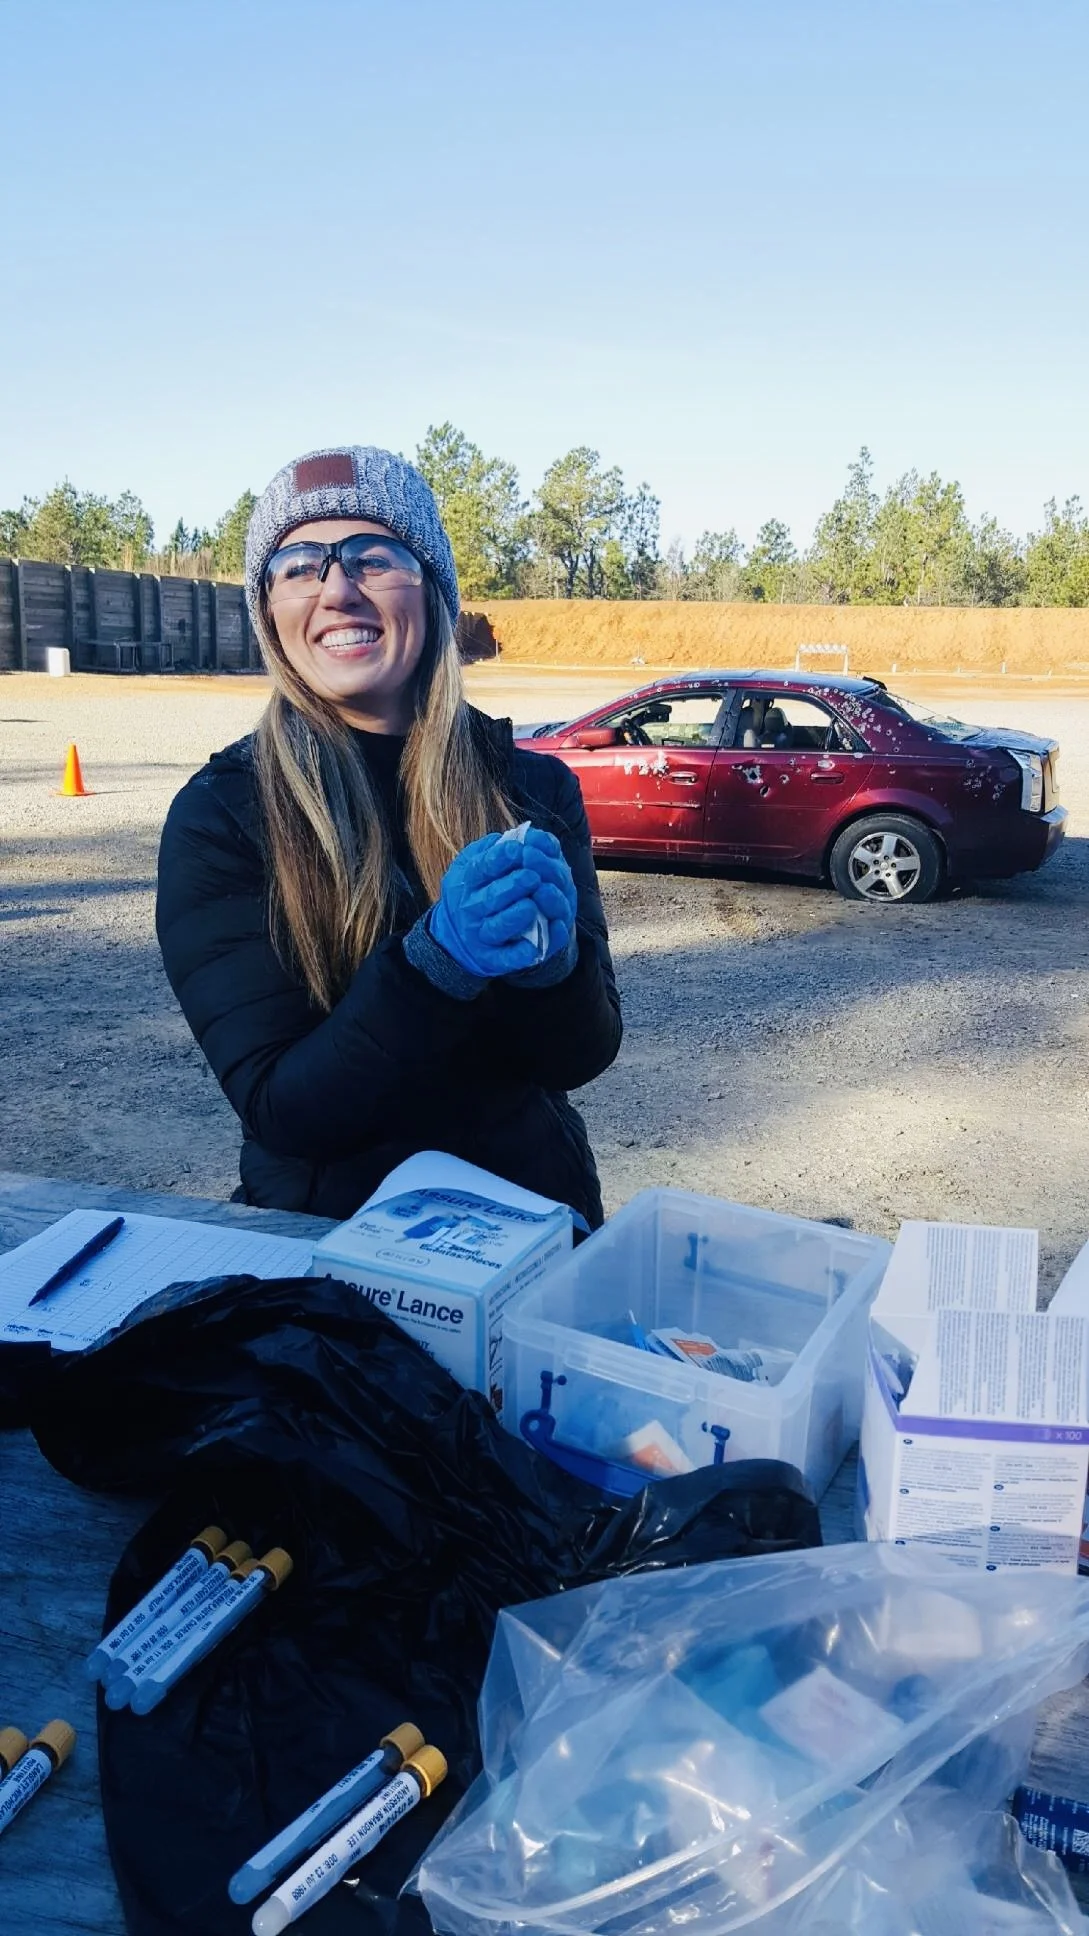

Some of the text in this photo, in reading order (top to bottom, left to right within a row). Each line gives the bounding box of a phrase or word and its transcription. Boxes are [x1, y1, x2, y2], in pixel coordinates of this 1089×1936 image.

[483, 1202, 548, 1224] Lance
[396, 1289, 465, 1325] Lance
[1064, 1430, 1083, 1441] 100
[347, 1834, 360, 1847] LEE
[314, 1867, 324, 1877] 23
[304, 1875, 316, 1886] Jul
